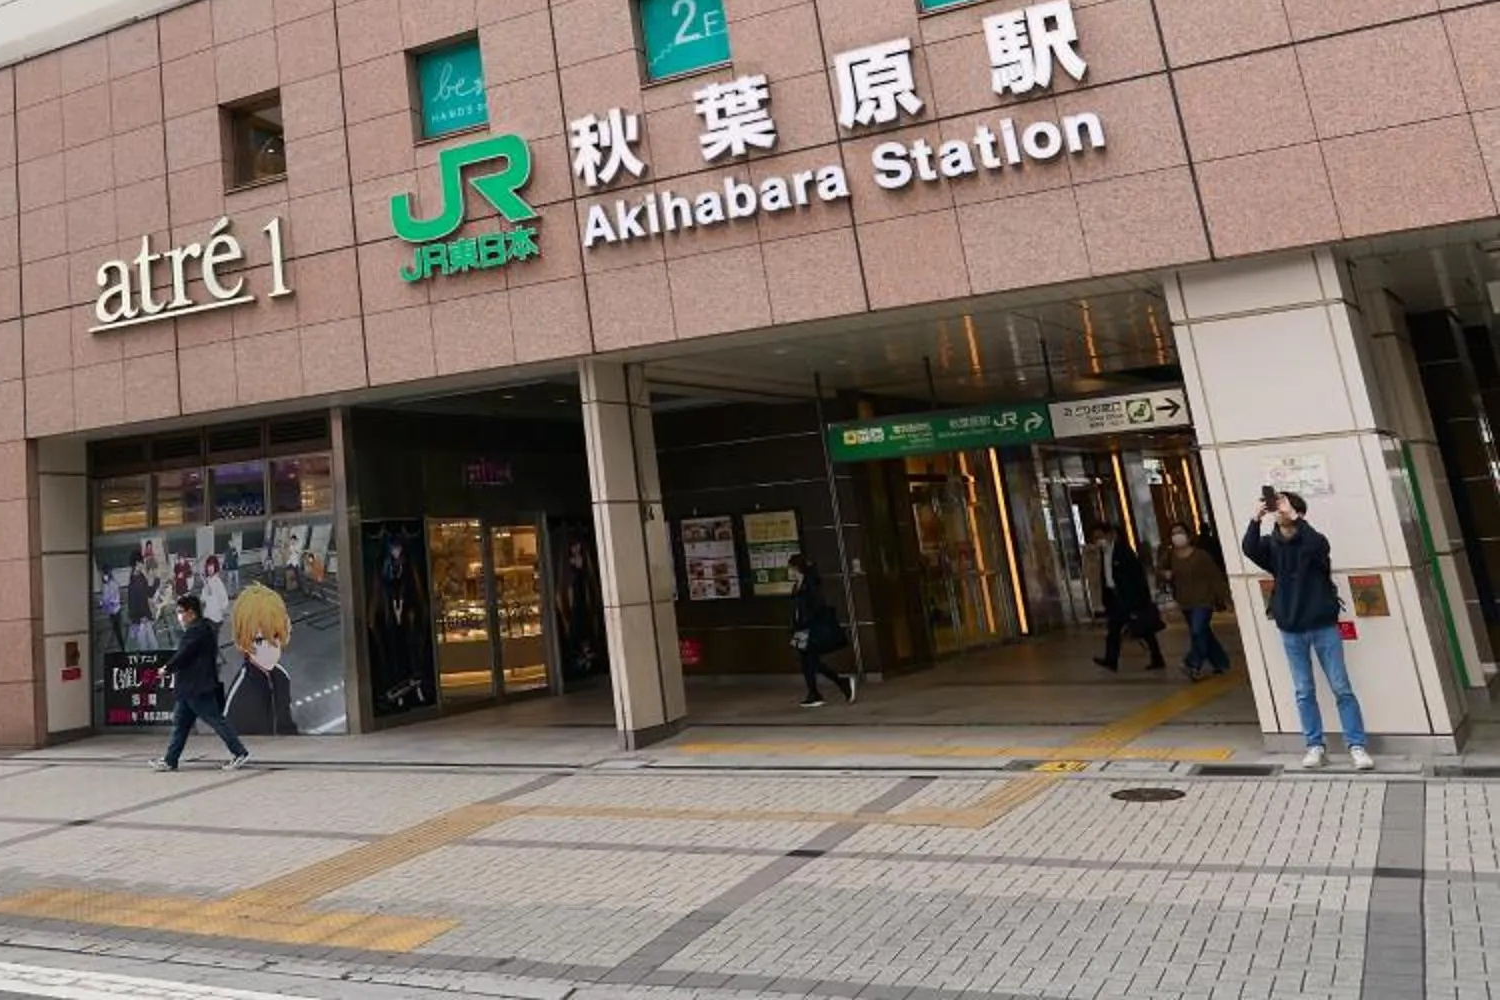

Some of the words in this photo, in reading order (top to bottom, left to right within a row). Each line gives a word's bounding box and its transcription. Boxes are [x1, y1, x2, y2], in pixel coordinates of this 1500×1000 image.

[431, 104, 473, 123] HANDS
[389, 132, 538, 242] JR
[583, 159, 850, 248] Akihabara
[872, 110, 1107, 191] Station
[94, 215, 246, 325] atré
[262, 216, 293, 298] 1
[399, 226, 540, 282] JR東日本
[992, 411, 1018, 427] JR
